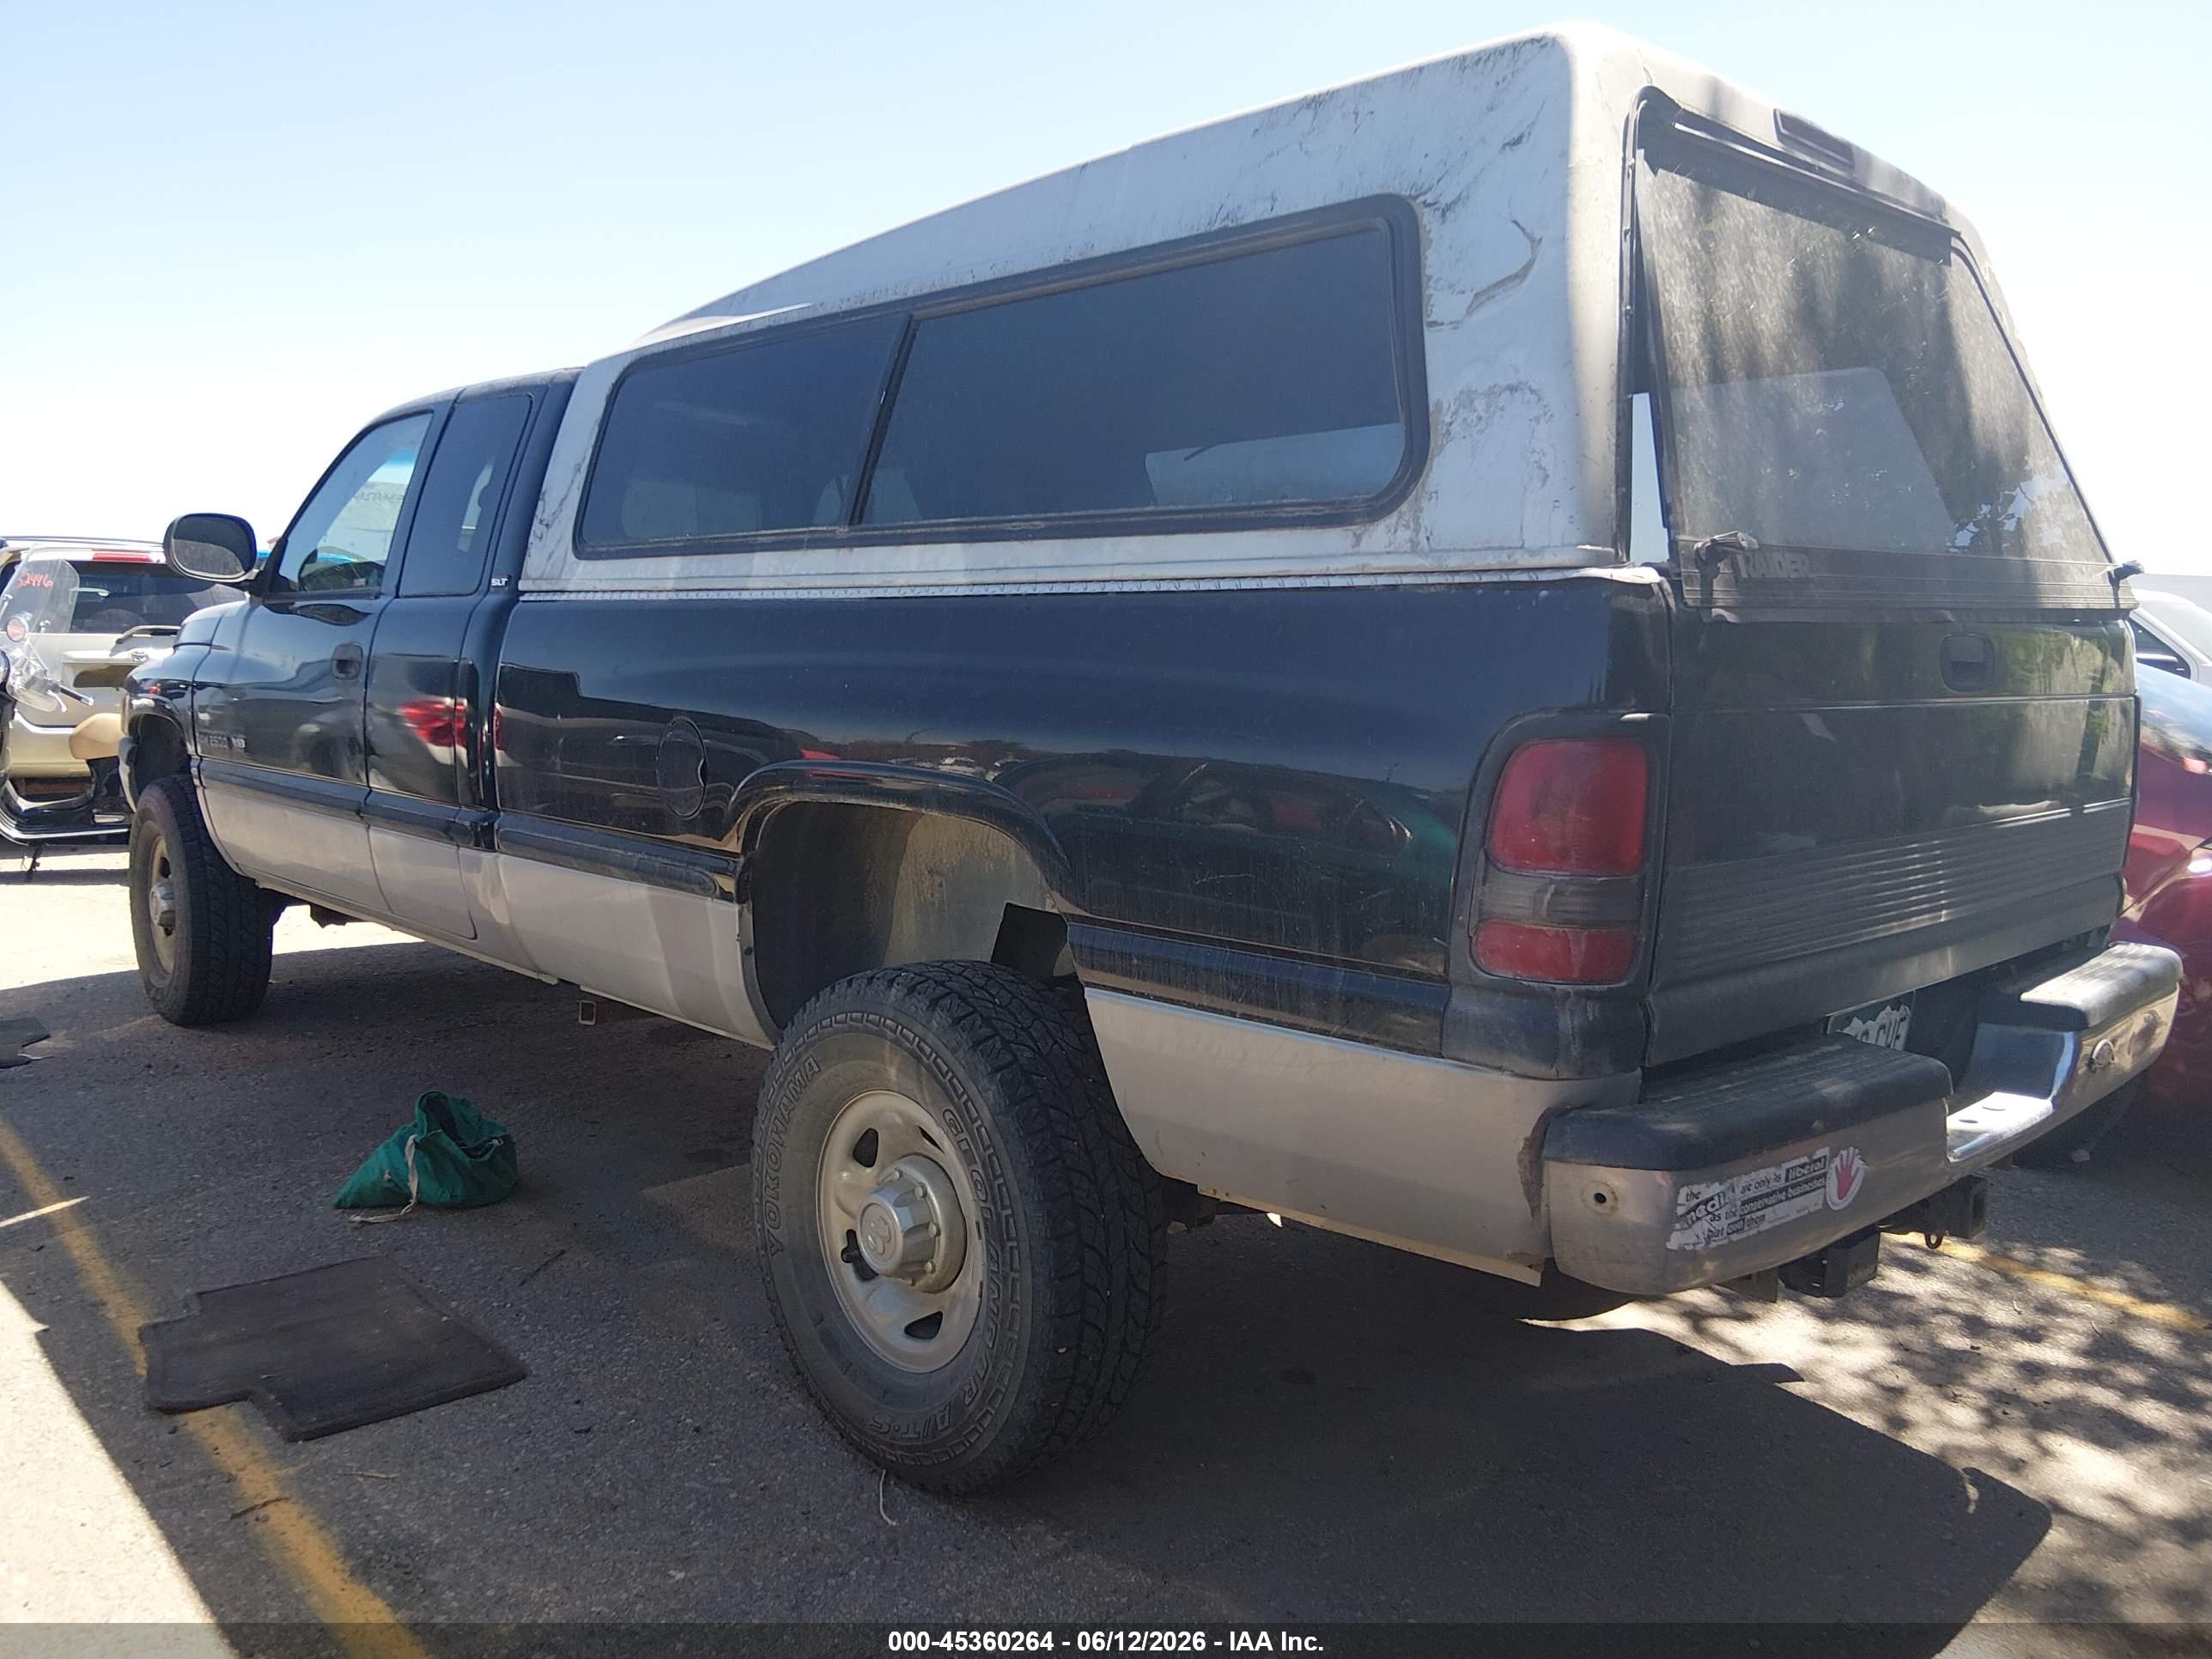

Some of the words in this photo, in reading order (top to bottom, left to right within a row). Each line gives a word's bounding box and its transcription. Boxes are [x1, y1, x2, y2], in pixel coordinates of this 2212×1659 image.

[1735, 551, 1808, 579] RAIDER
[490, 577, 509, 586] SLT
[764, 1056, 821, 1258] YOKOHAMA
[1788, 1157, 1826, 1181] liberal
[1686, 1187, 1701, 1202] the
[1710, 1212, 1723, 1223] as
